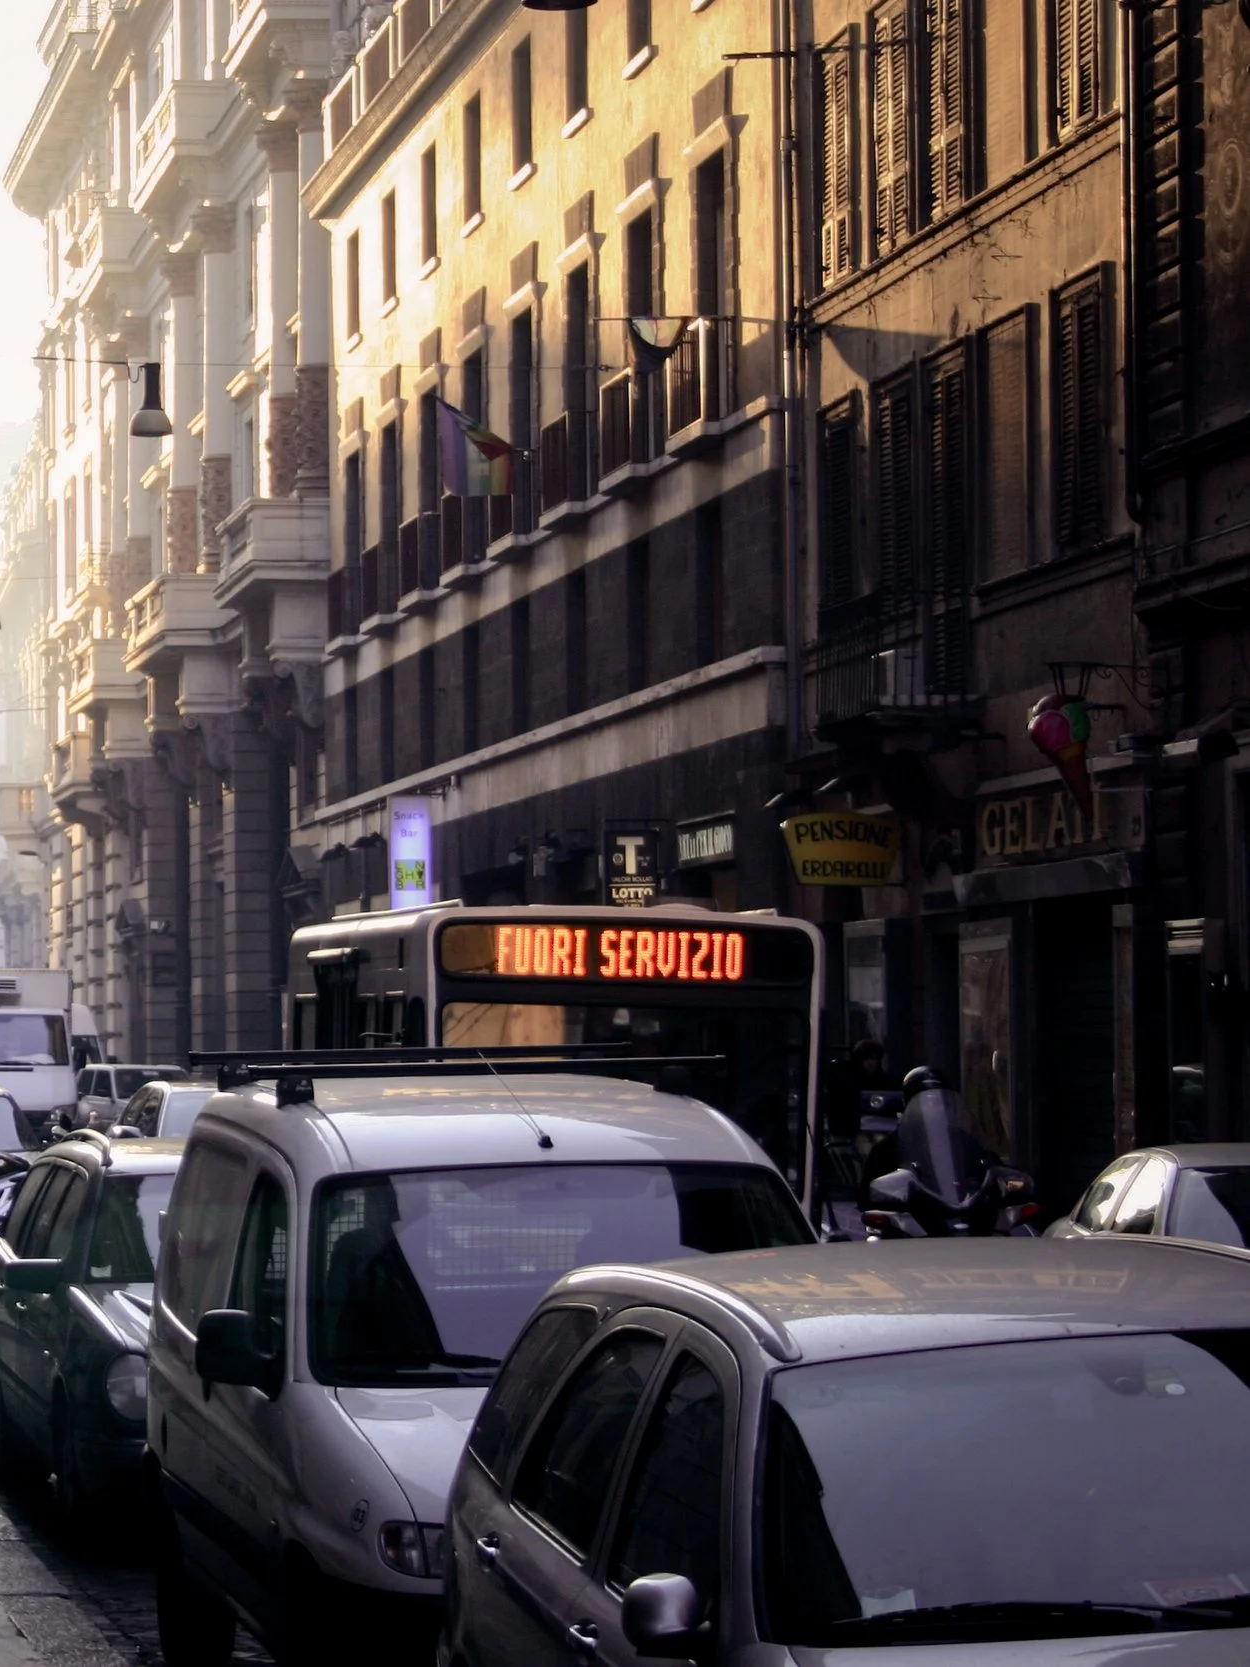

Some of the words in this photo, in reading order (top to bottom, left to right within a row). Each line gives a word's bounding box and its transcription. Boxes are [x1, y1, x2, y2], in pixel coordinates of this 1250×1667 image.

[400, 828, 418, 838] Bar
[794, 819, 891, 849] PENSIONE
[616, 836, 645, 875] T
[612, 887, 653, 899] LOTTO
[497, 927, 587, 976] FUORI
[600, 929, 744, 980] SERVIZIO
